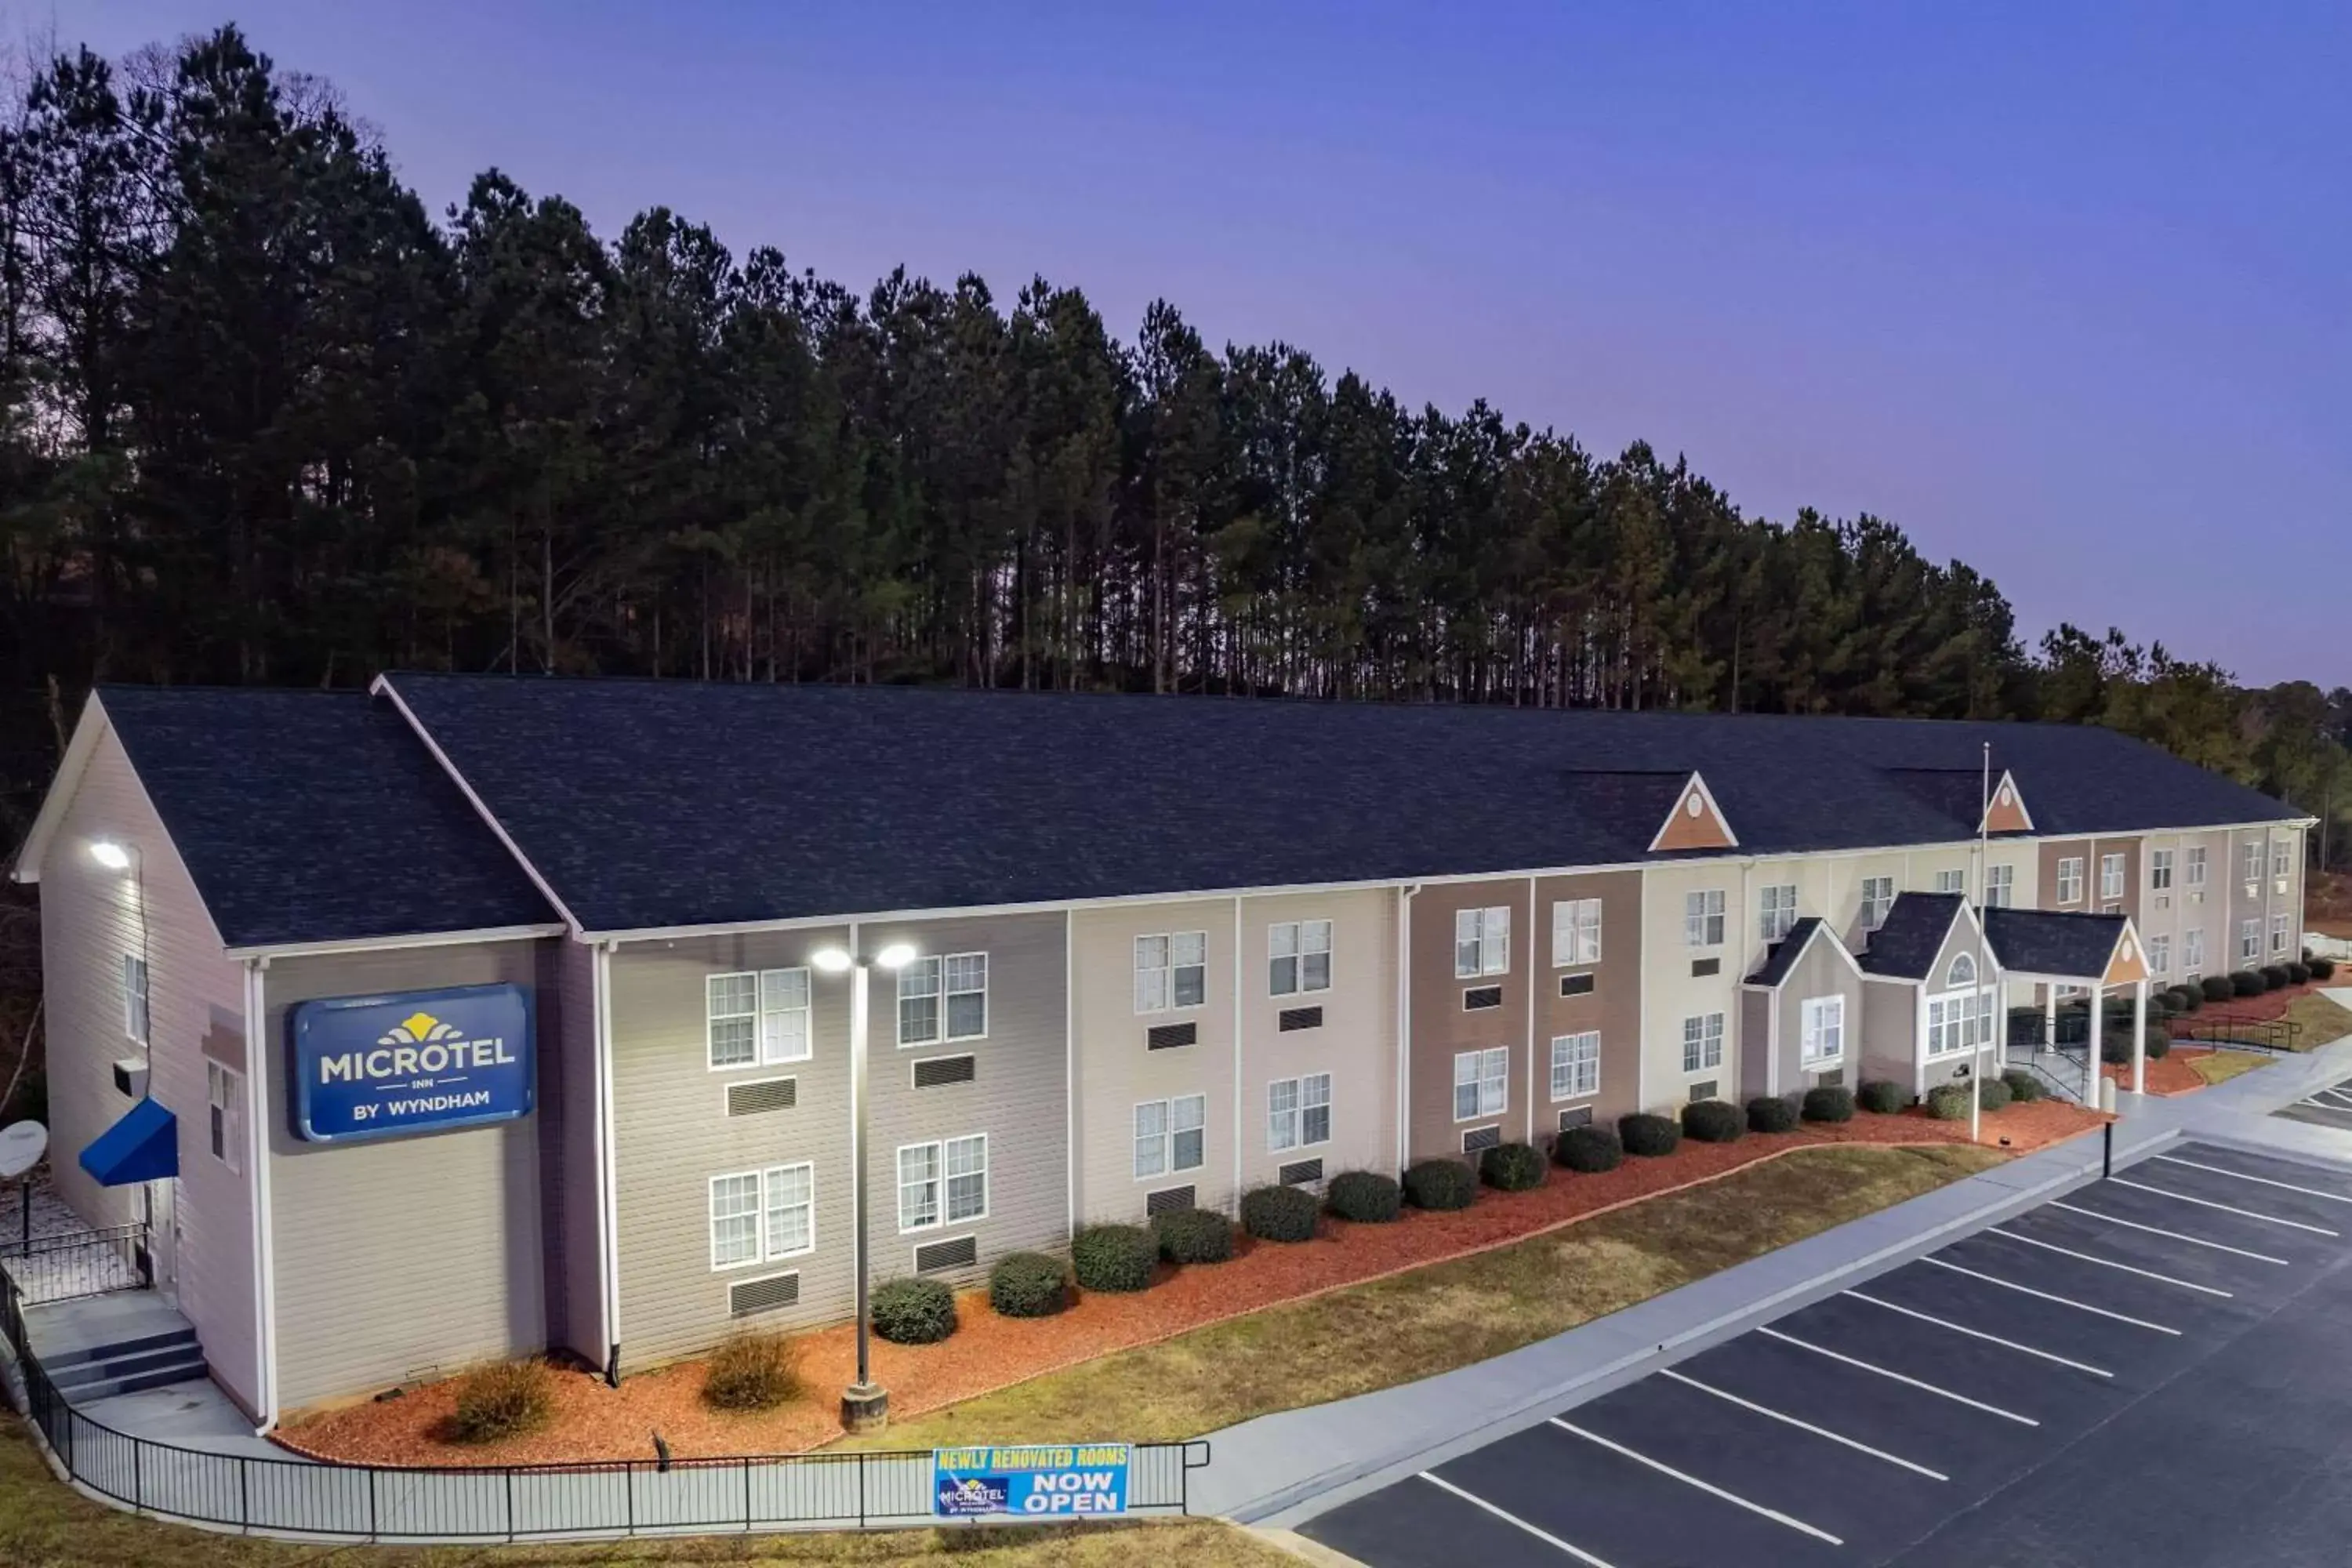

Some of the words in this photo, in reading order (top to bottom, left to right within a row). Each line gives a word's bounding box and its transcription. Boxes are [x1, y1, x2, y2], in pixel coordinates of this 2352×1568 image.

[321, 1038, 515, 1083] MICROTEL
[412, 1078, 434, 1089] INN
[354, 1103, 379, 1120] BY
[388, 1091, 490, 1116] WYNDHAM
[938, 1450, 988, 1469] NEWLY
[992, 1449, 1073, 1468] RENOVATED
[1076, 1447, 1127, 1467] ROOMS
[1034, 1472, 1113, 1491] NOW
[940, 1489, 1004, 1503] MICROTEL
[1024, 1493, 1117, 1512] OPEN
